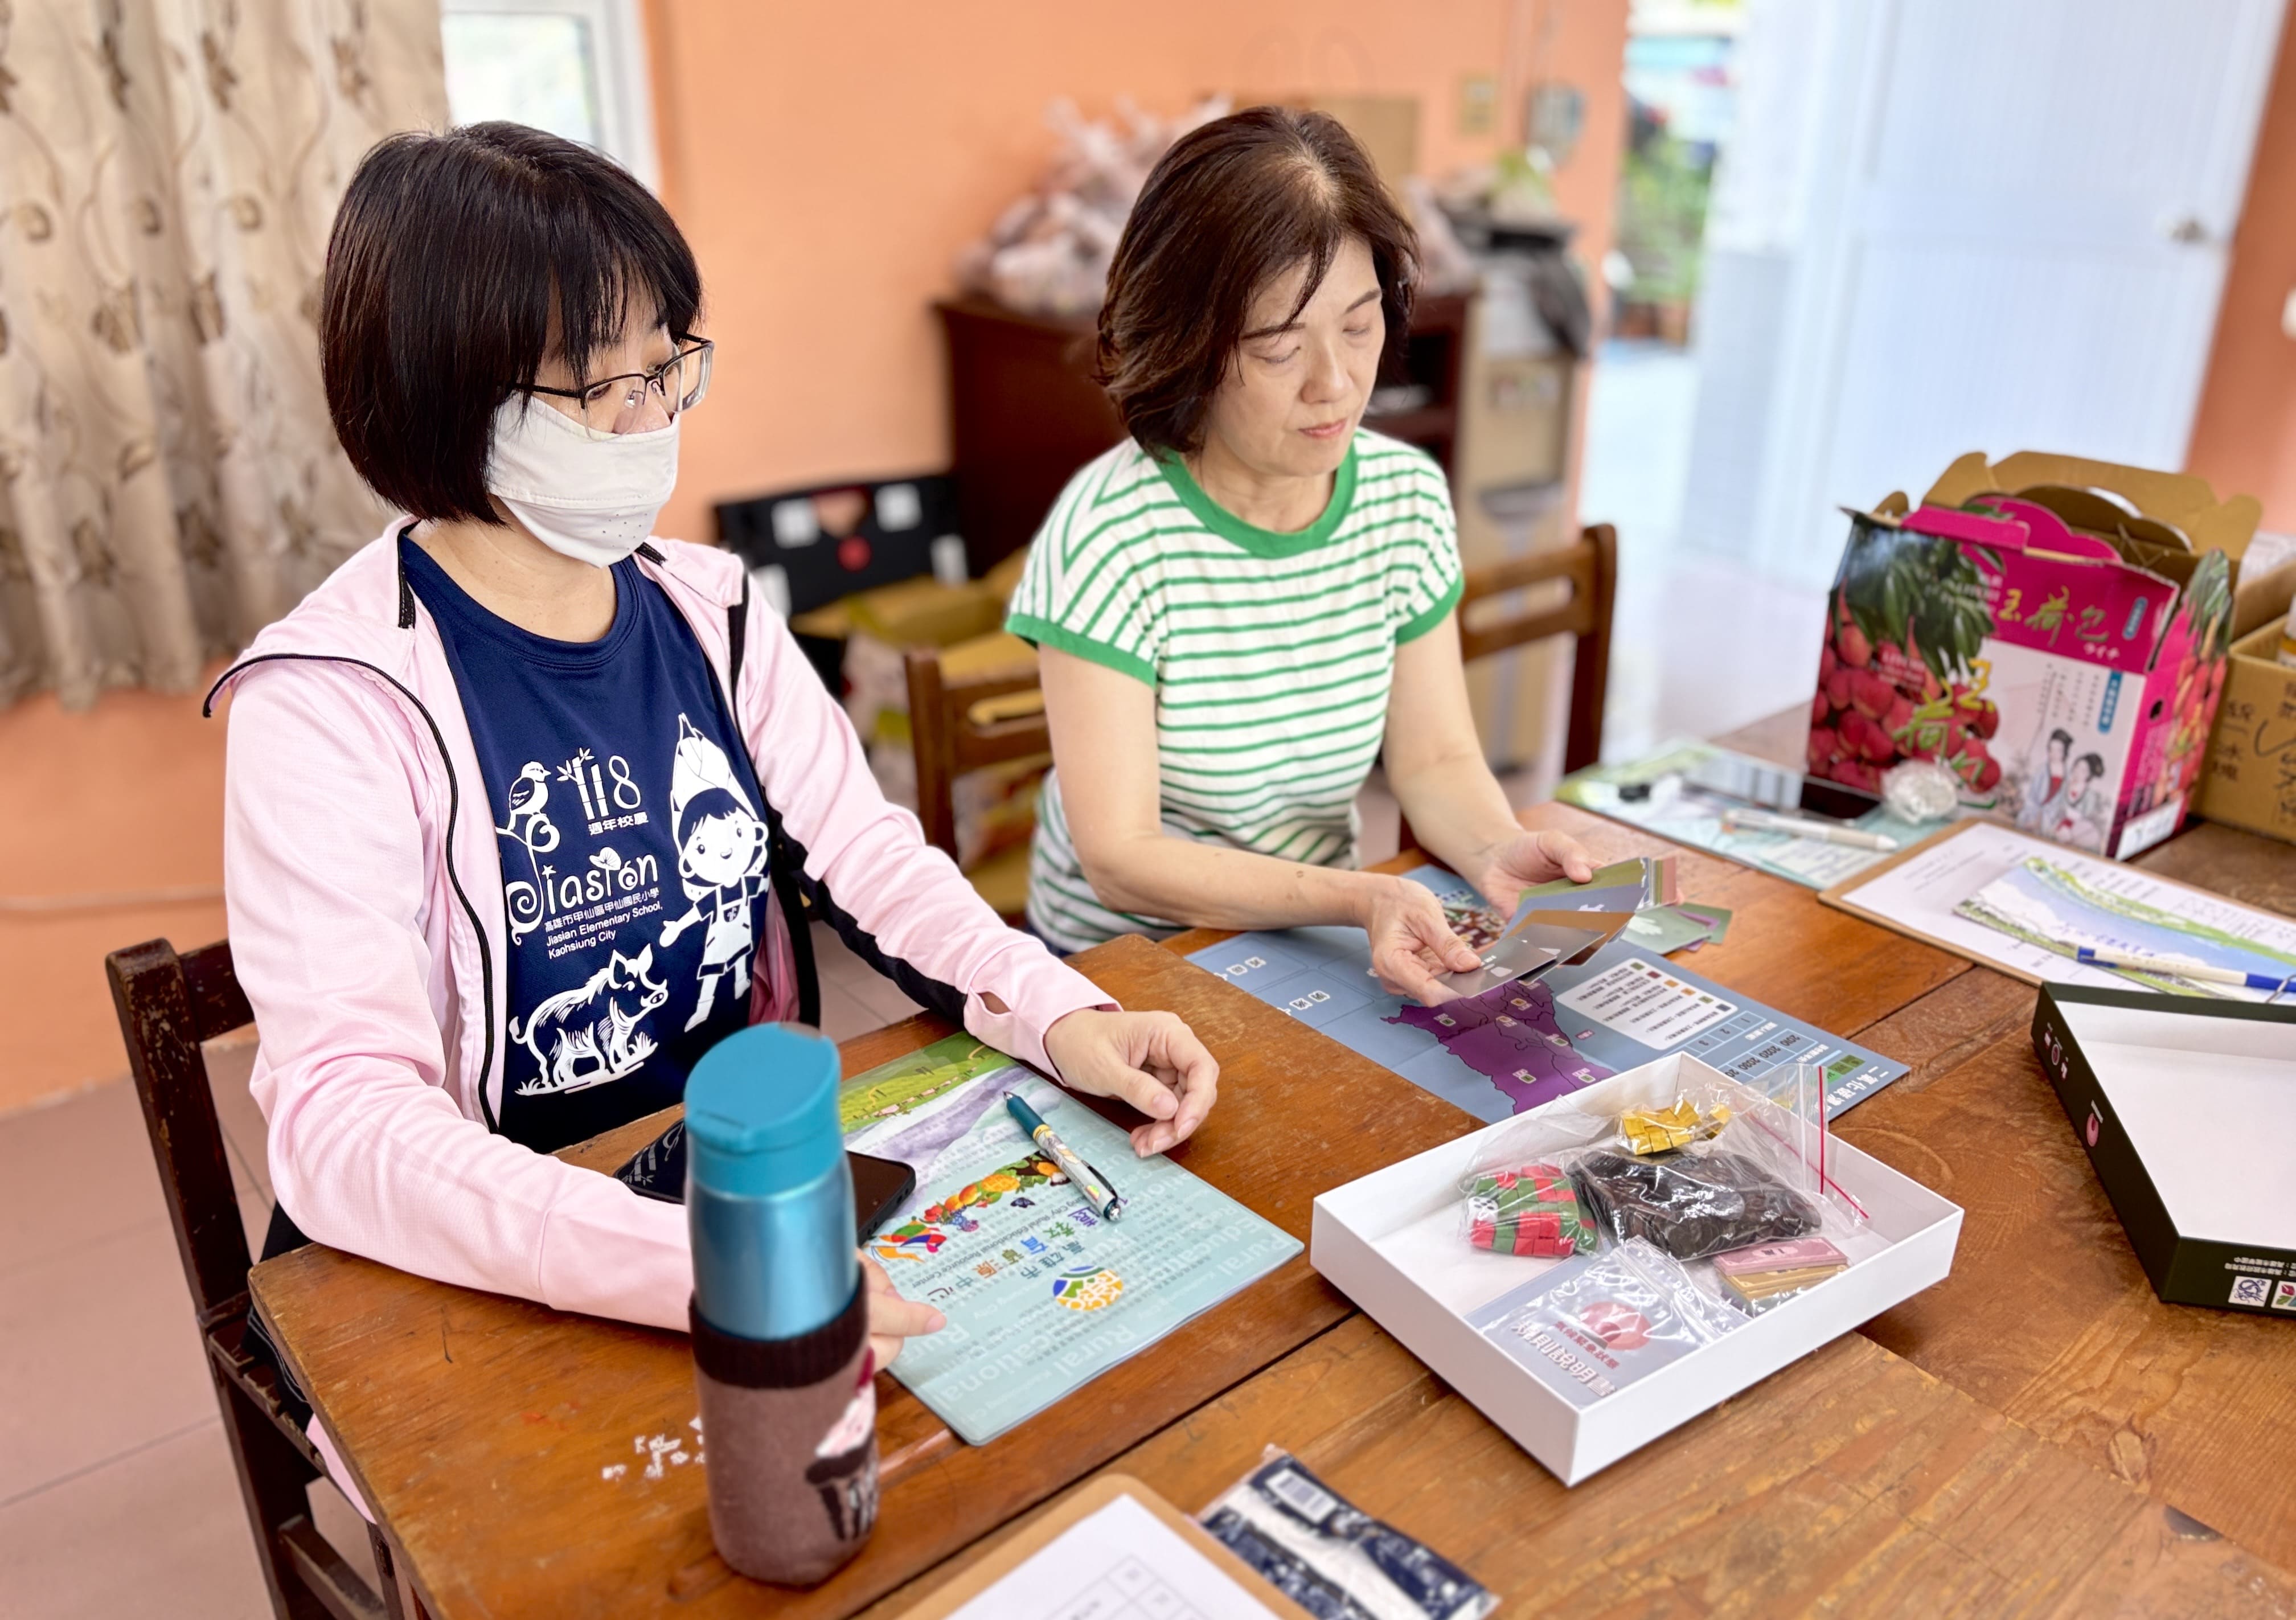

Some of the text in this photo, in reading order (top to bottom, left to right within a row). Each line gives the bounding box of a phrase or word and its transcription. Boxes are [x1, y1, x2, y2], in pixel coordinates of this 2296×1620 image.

[588, 811, 649, 835] 週年校慶
[544, 887, 659, 933] 高雄市甲仙區甲仙國民小學
[547, 929, 577, 946] Jiasian
[579, 912, 631, 936] Elementary
[548, 929, 616, 959] Kaohsiung City
[1758, 1045, 1781, 1059] 2020
[1779, 1034, 1801, 1047] 2010
[1027, 1214, 1051, 1229] Rural
[927, 1196, 1128, 1302] 遠教育資源中心
[980, 1226, 1029, 1253] Educational
[941, 1250, 982, 1273] Resource
[1020, 1240, 1085, 1279] 高雄市
[912, 1270, 942, 1288] Center
[1511, 1320, 1617, 1397] 規則說明書
